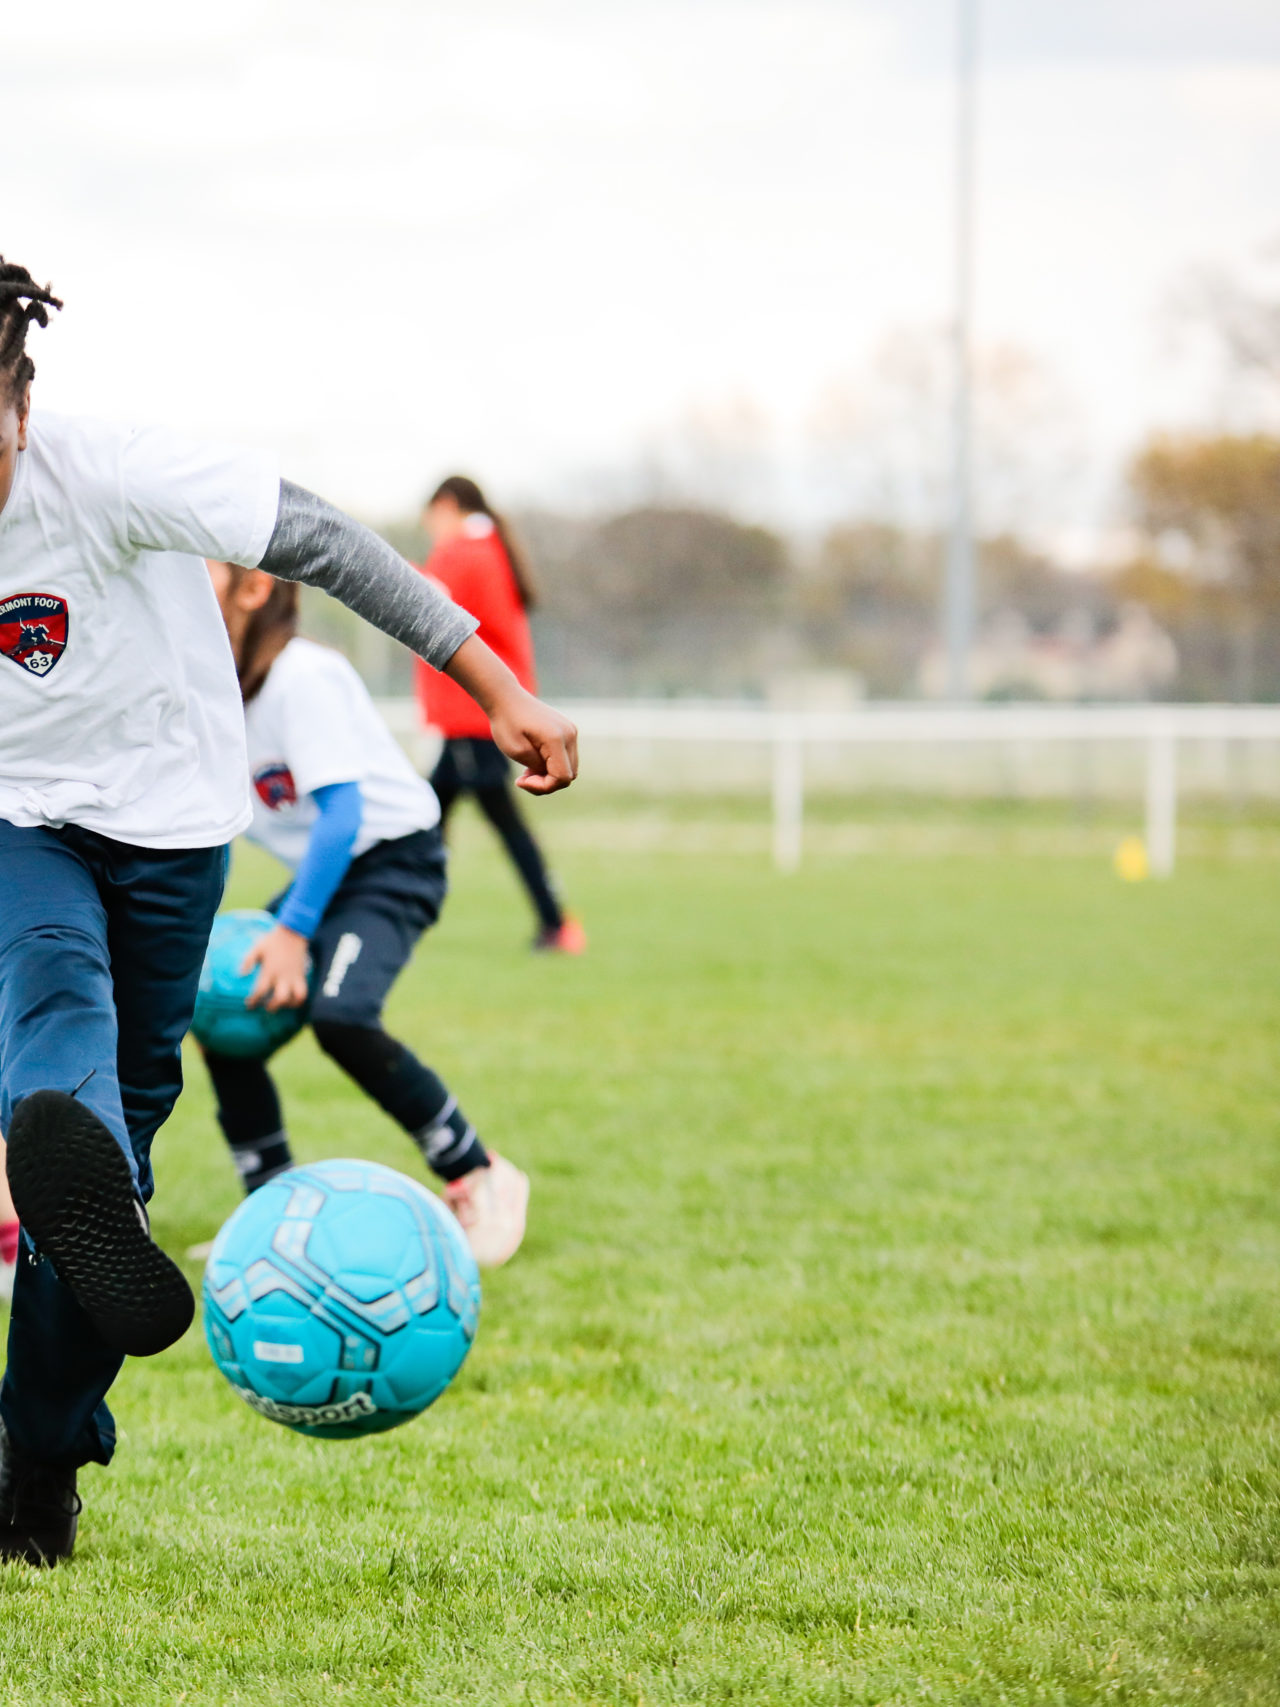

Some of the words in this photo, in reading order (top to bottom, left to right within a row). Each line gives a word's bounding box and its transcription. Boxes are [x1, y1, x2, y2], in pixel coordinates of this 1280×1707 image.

[34, 597, 60, 610] FOOT
[29, 656, 49, 669] 63
[232, 1384, 376, 1426] sport
